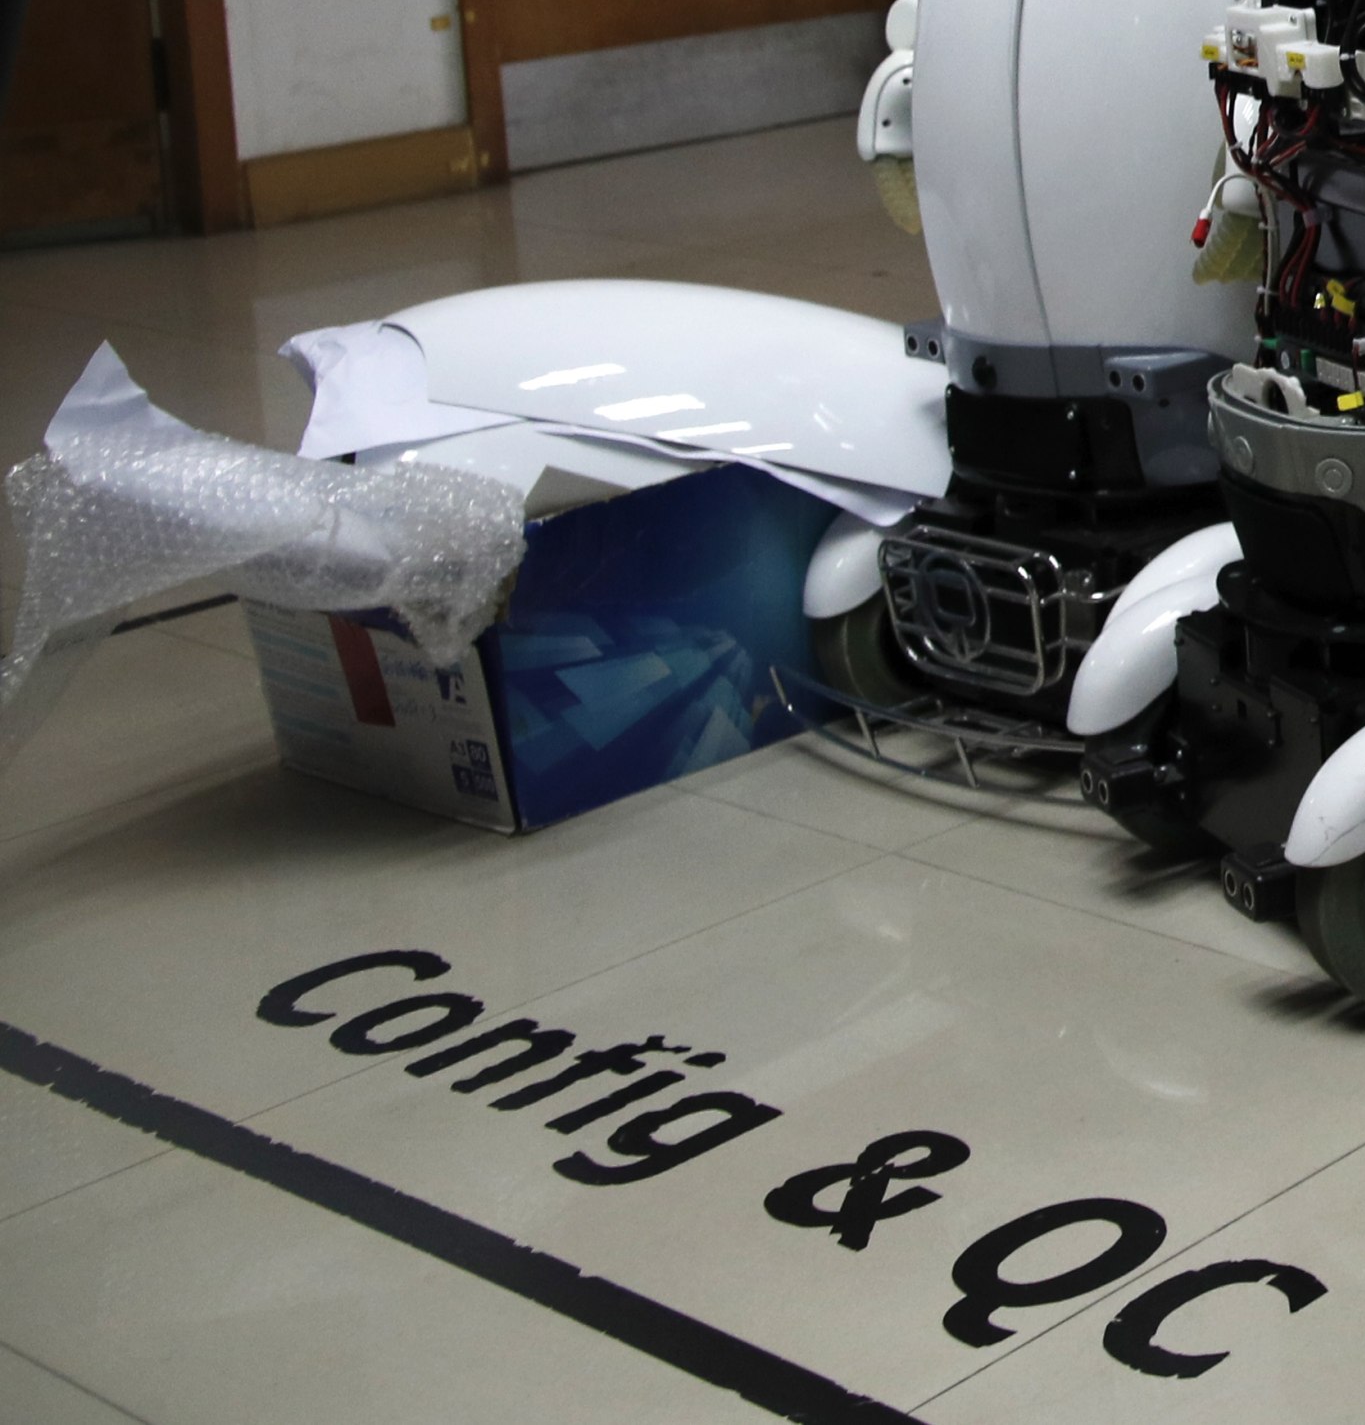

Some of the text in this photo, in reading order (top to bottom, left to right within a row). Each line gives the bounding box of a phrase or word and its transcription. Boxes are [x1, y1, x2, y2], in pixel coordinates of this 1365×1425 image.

[256, 950, 1328, 1380] Config & QC
